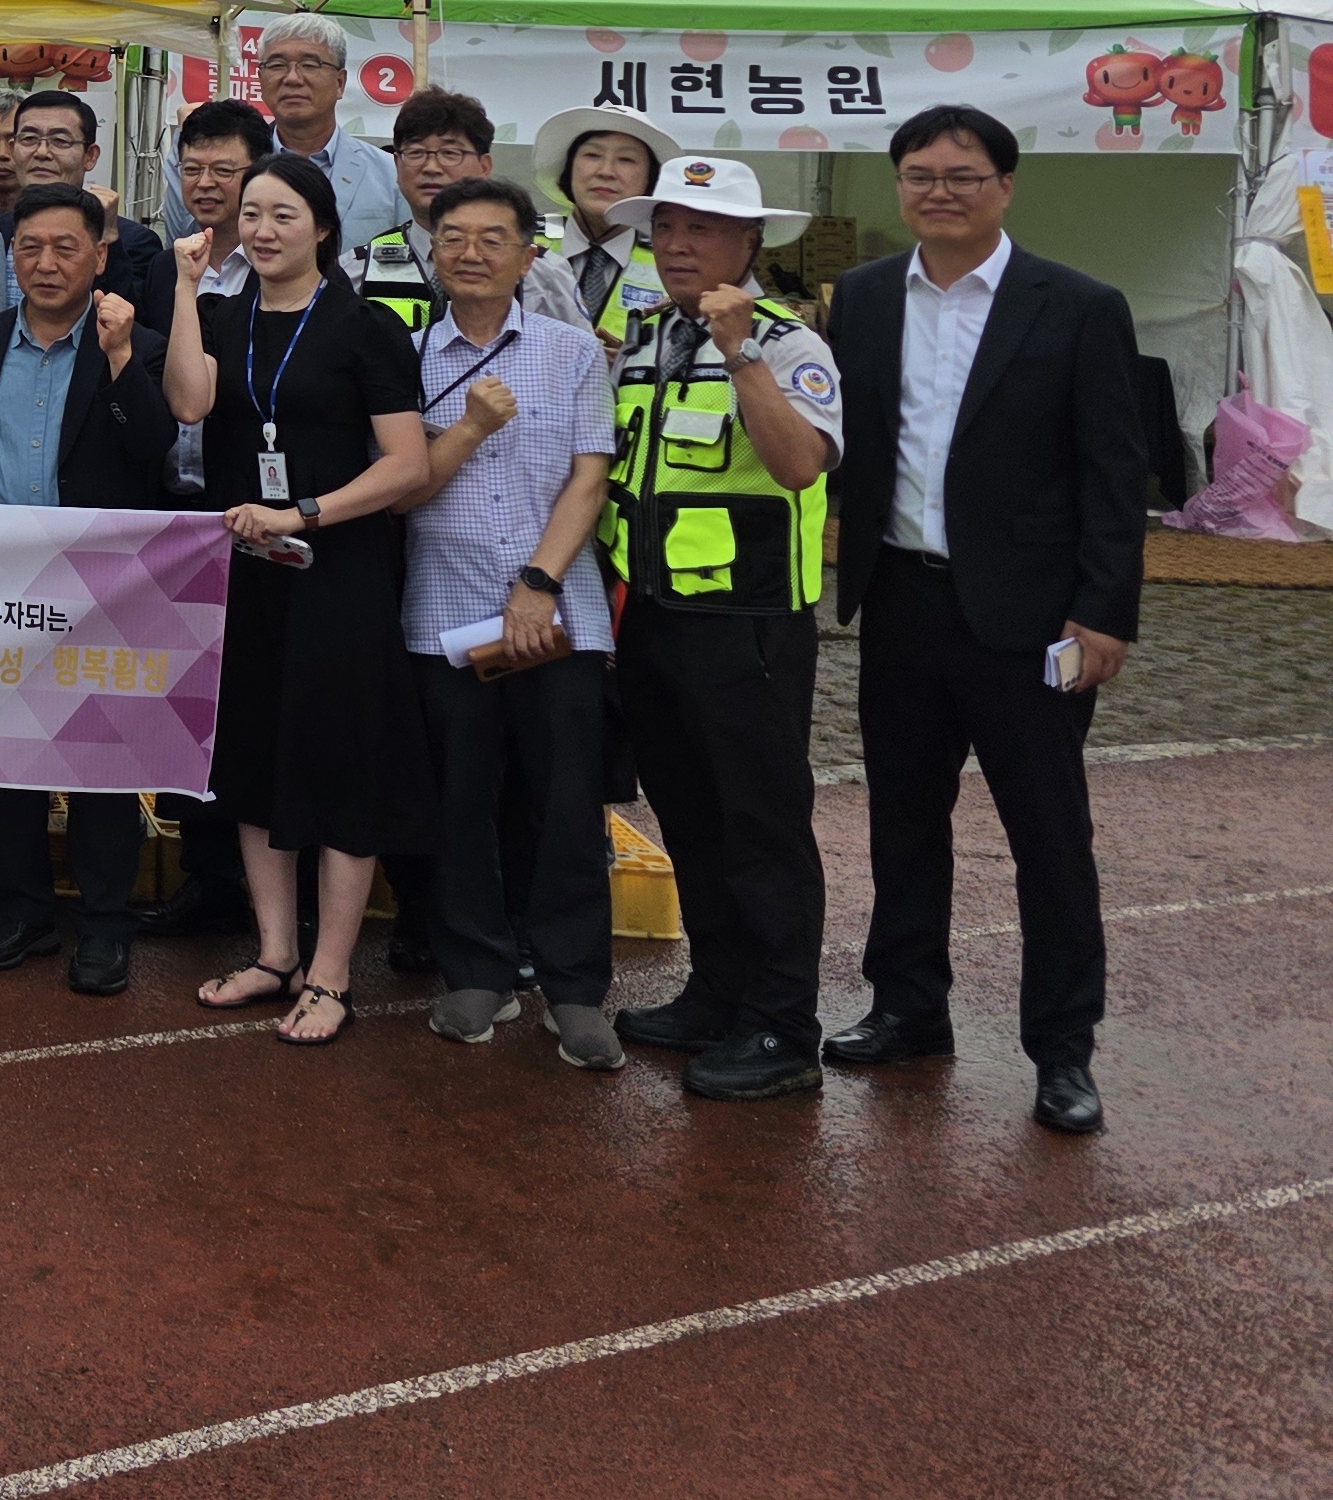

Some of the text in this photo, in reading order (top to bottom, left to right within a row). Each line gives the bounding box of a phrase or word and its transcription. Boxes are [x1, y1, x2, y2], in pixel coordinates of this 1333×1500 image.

[378, 67, 397, 92] 2
[593, 59, 887, 116] 세현농원
[52, 645, 170, 694] 행복횡성
